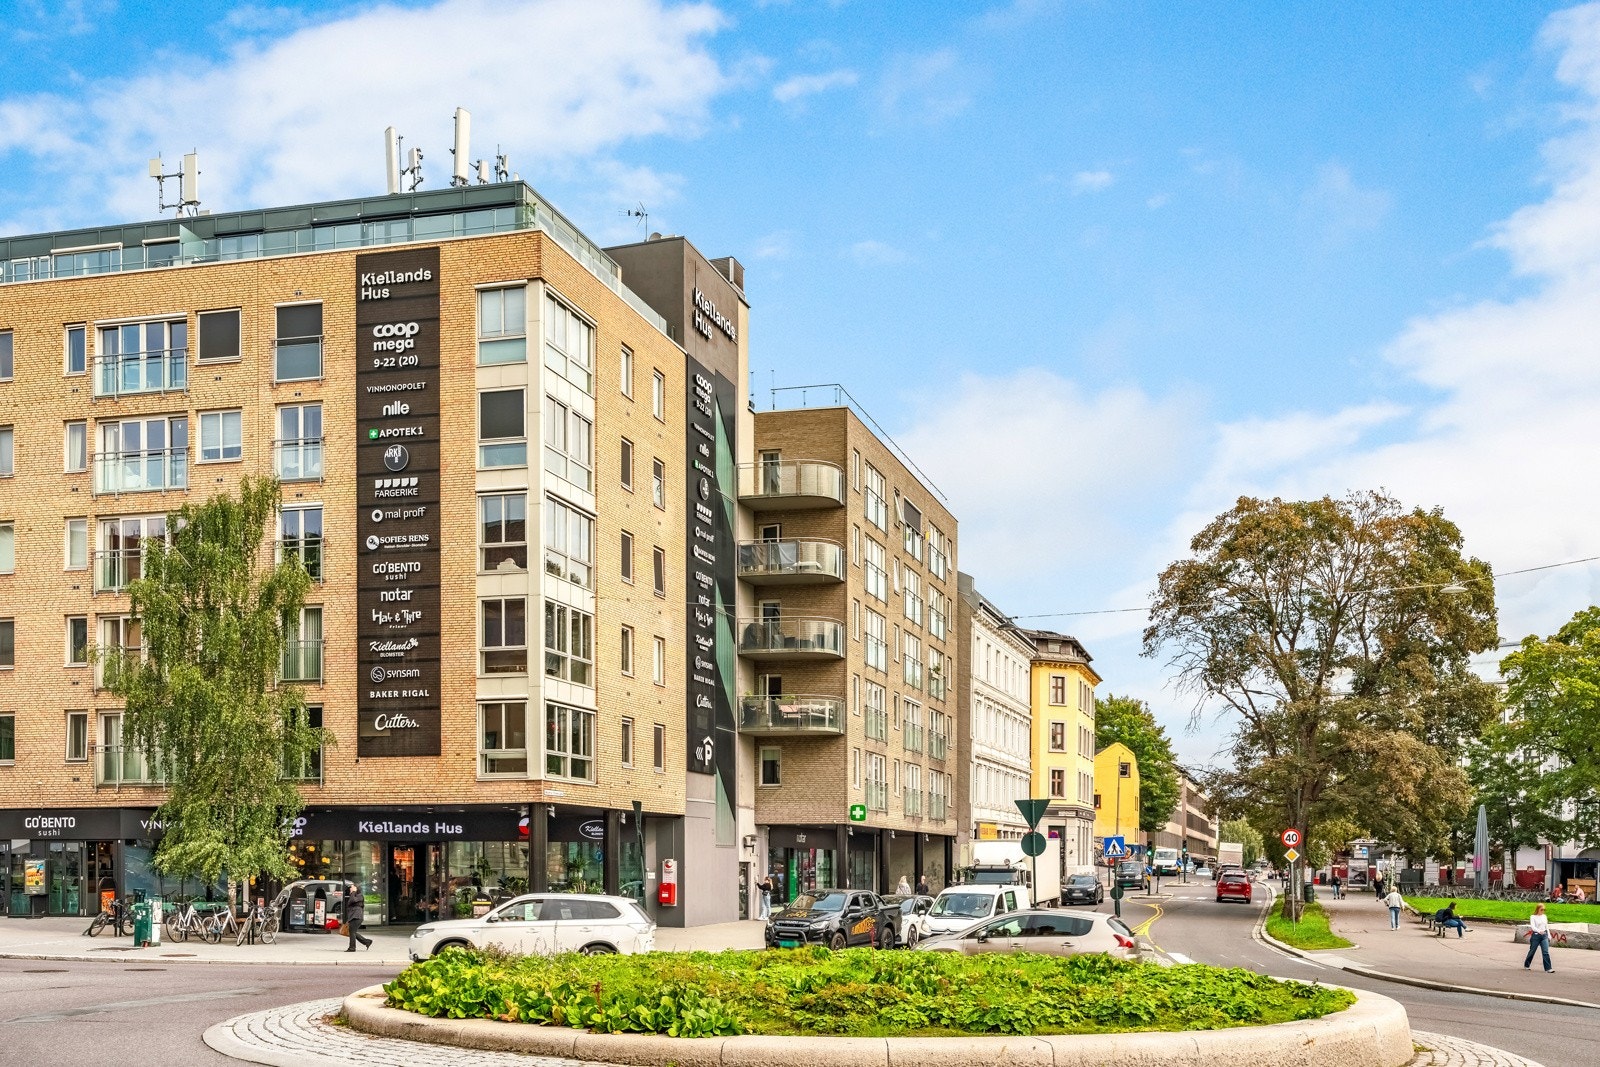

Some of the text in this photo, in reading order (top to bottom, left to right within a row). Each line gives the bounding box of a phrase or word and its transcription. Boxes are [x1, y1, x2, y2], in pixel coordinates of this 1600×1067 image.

[361, 268, 432, 286] Kiellands
[361, 287, 390, 300] Hus
[695, 287, 736, 339] Kiellands
[373, 322, 419, 338] coop
[695, 309, 713, 340] Hus
[373, 338, 414, 353] mega
[373, 355, 419, 368] 9-22 (20)
[366, 382, 426, 393] VINMONOPOLET
[696, 373, 713, 394] coop
[382, 400, 410, 416] nille
[374, 487, 419, 498] FARGERIKE
[385, 506, 427, 520] mal proff
[380, 533, 430, 544] SOFIES RENS
[385, 573, 407, 581] sushi
[380, 588, 414, 602] notar
[394, 612, 401, 622] &
[369, 640, 413, 652] Kiellands
[369, 689, 430, 698] BAKER RIGAL
[704, 744, 713, 766] P
[358, 820, 463, 834] Kiellands Hus
[1285, 833, 1298, 843] 40
